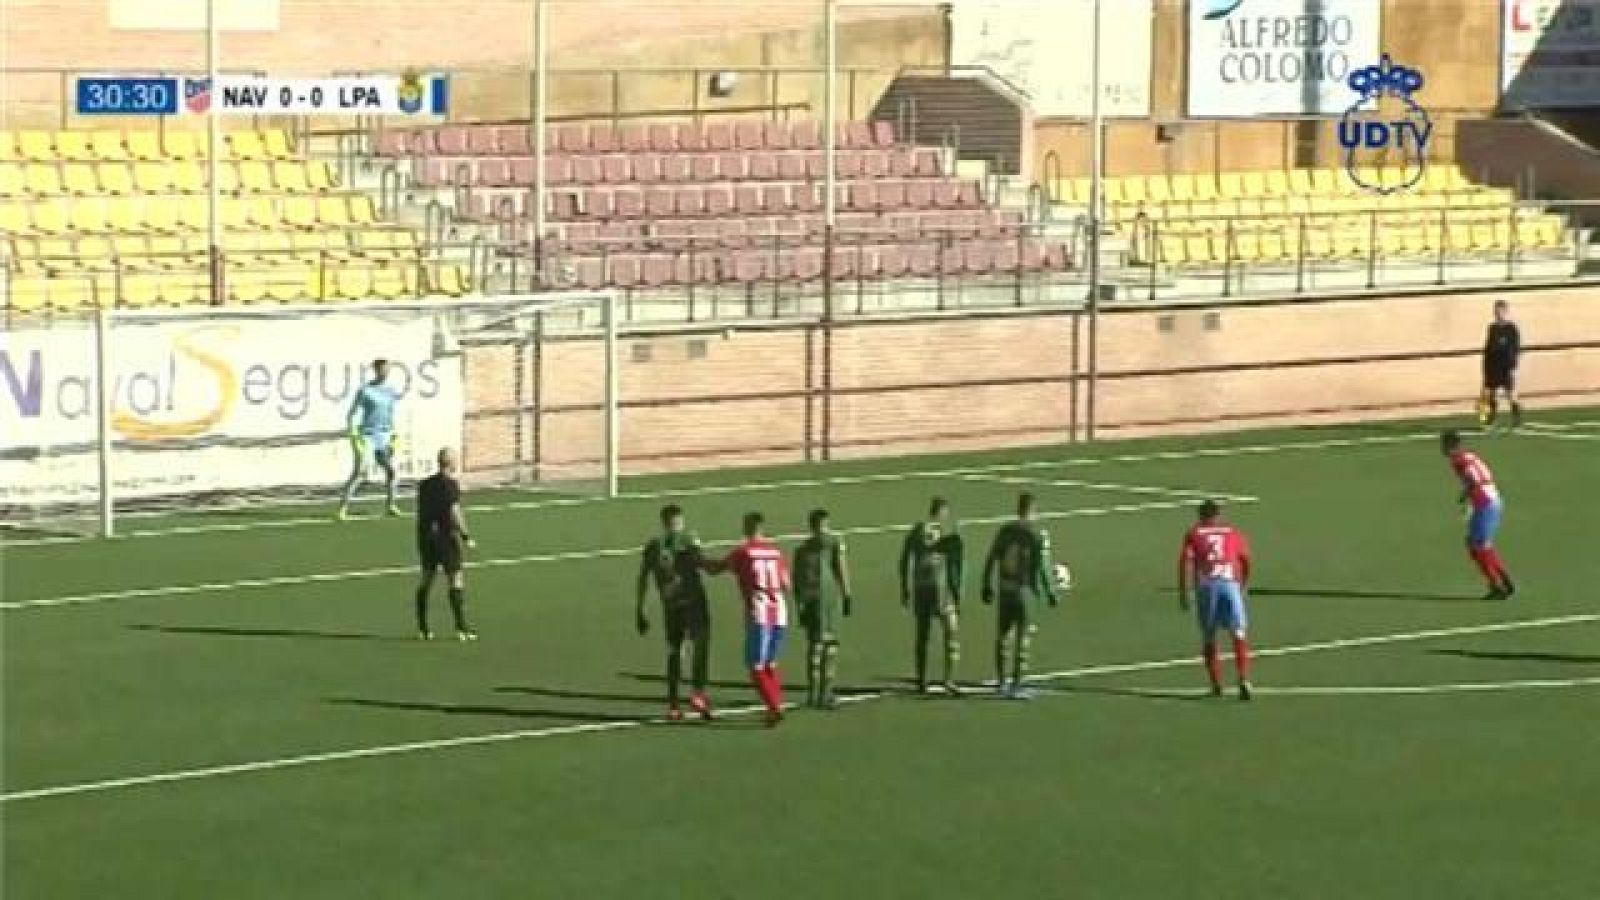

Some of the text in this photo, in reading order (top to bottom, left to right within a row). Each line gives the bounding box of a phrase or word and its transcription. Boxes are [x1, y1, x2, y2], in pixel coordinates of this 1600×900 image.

[1220, 15, 1353, 48] ALFREDO
[1219, 51, 1350, 83] COLOMO
[1206, 534, 1226, 561] 3
[753, 559, 779, 588] 11
